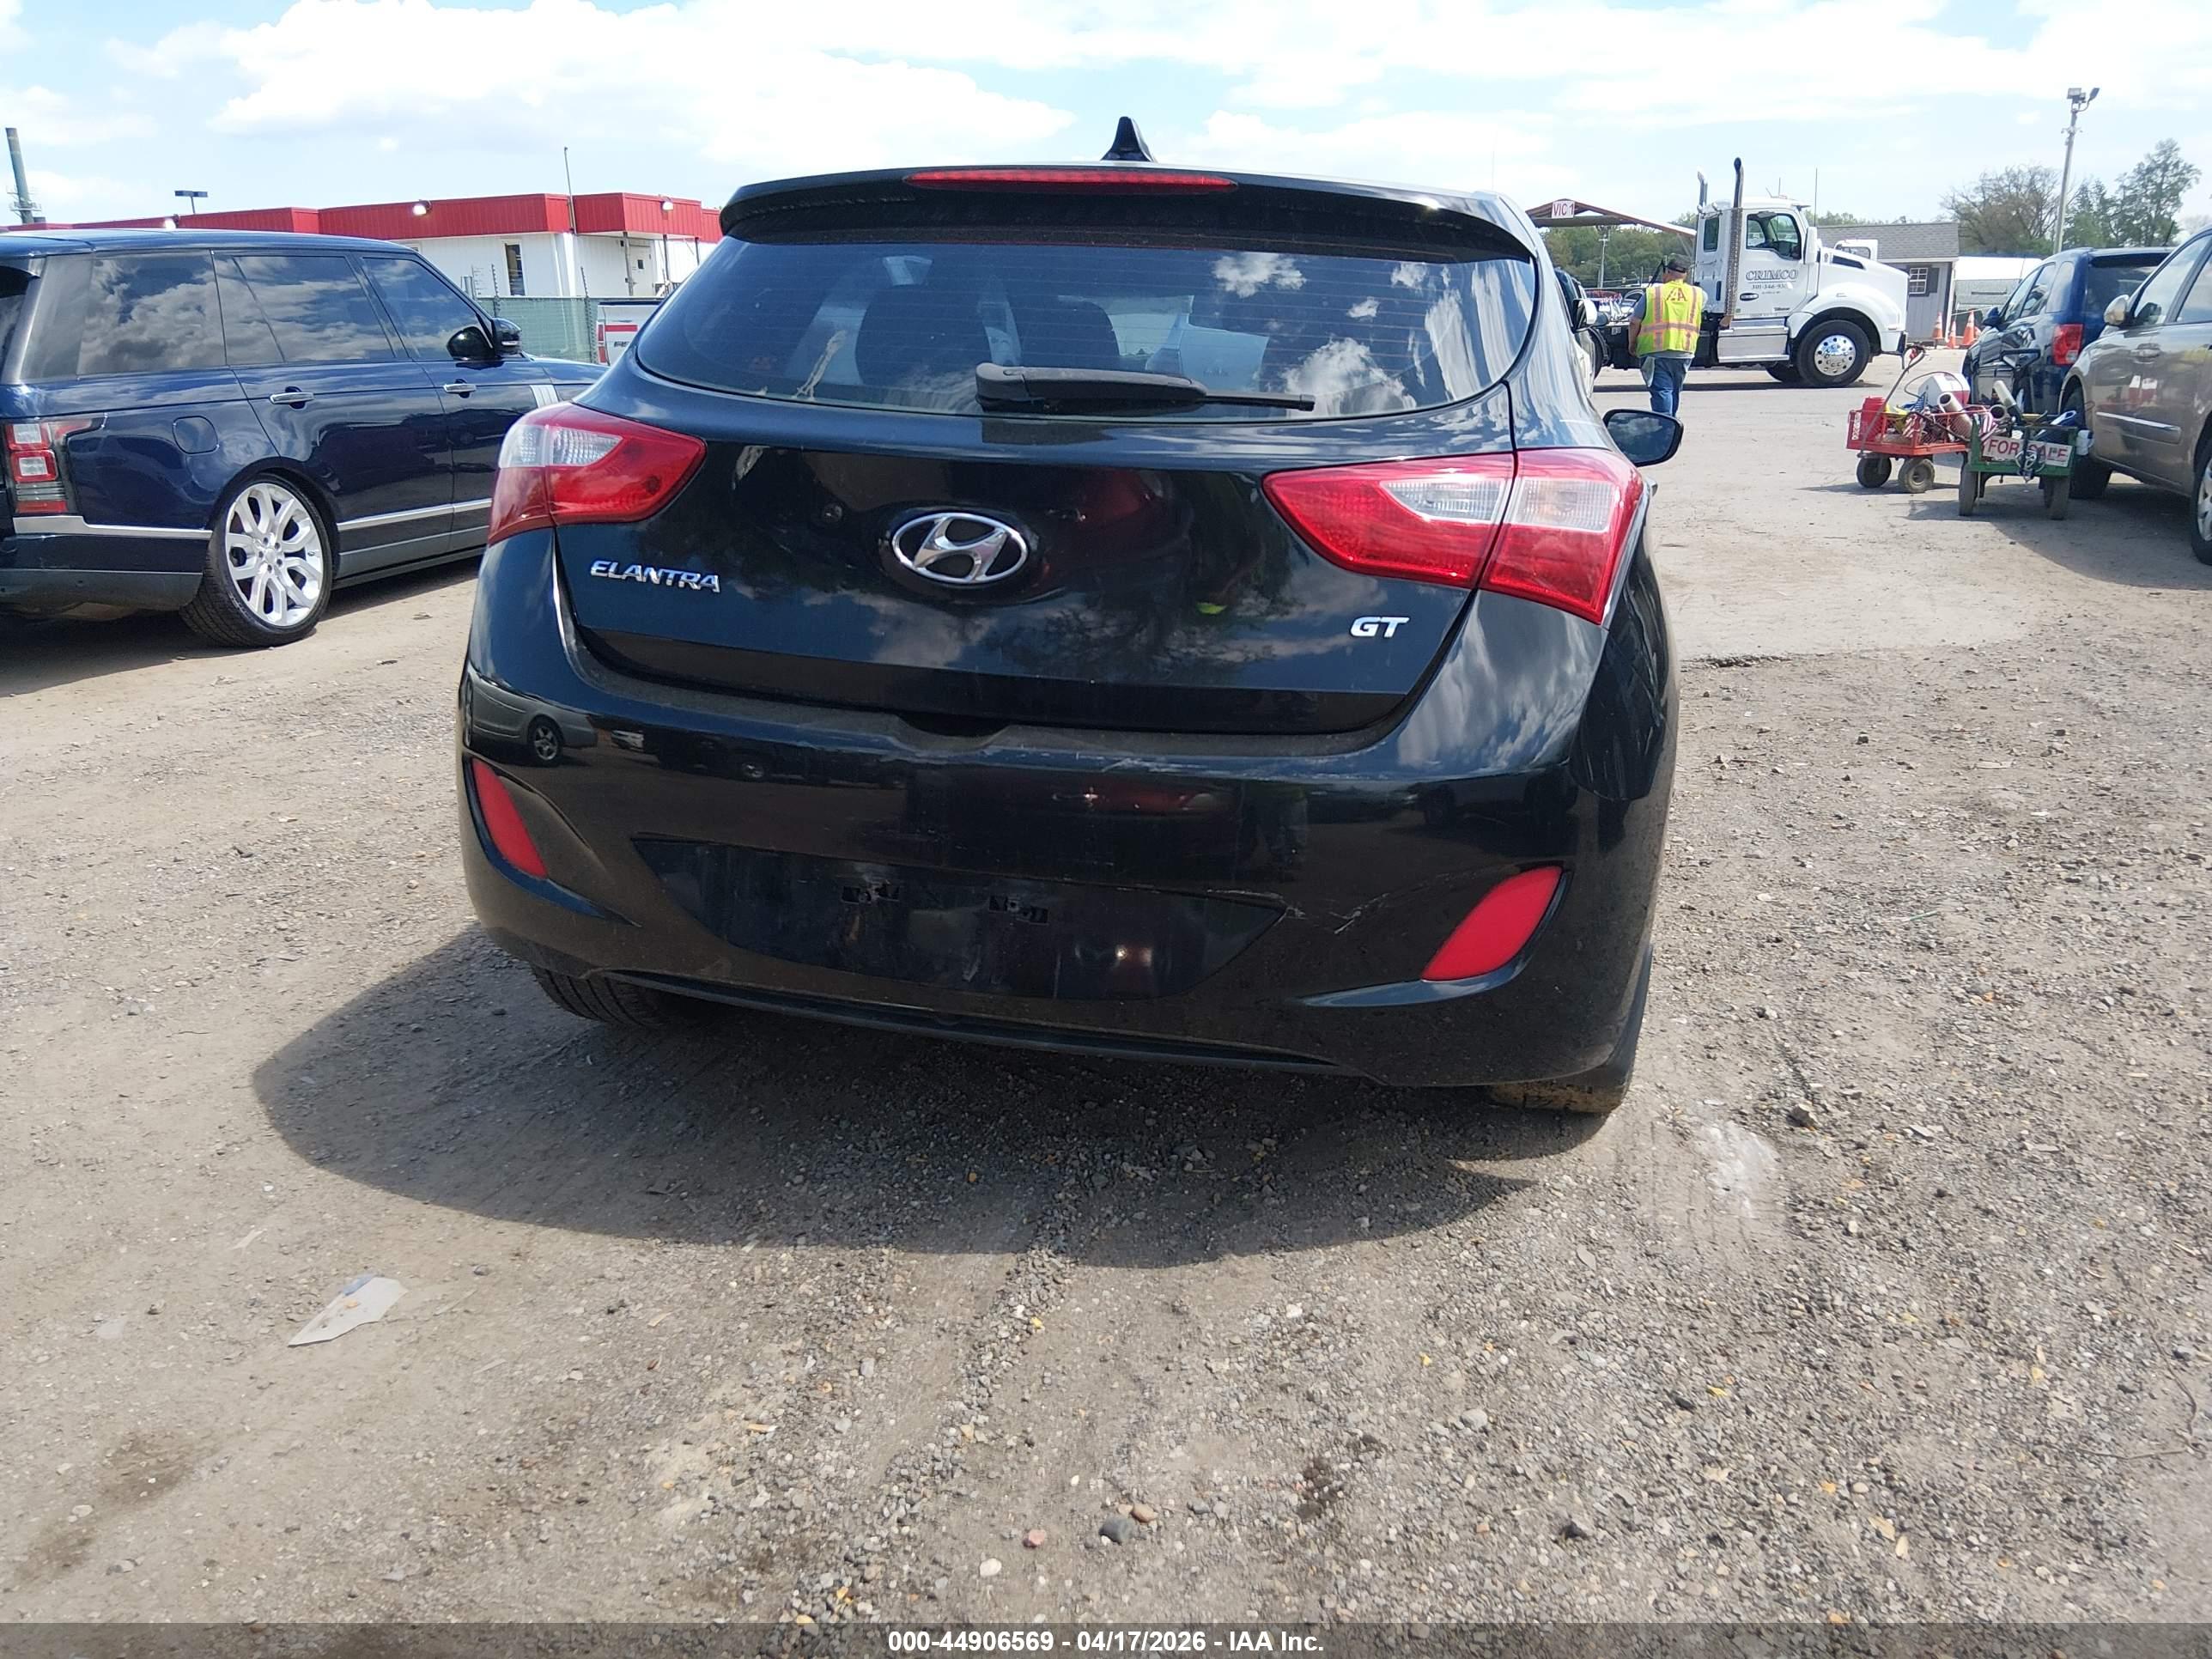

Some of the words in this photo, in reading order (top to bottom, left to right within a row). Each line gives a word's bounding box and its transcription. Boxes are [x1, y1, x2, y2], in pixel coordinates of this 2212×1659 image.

[1553, 204, 1568, 216] VIC
[1746, 269, 1798, 280] CRIMCO
[1988, 439, 2021, 456] FOR
[590, 560, 721, 593] ELANTRA
[1350, 617, 1411, 638] GT
